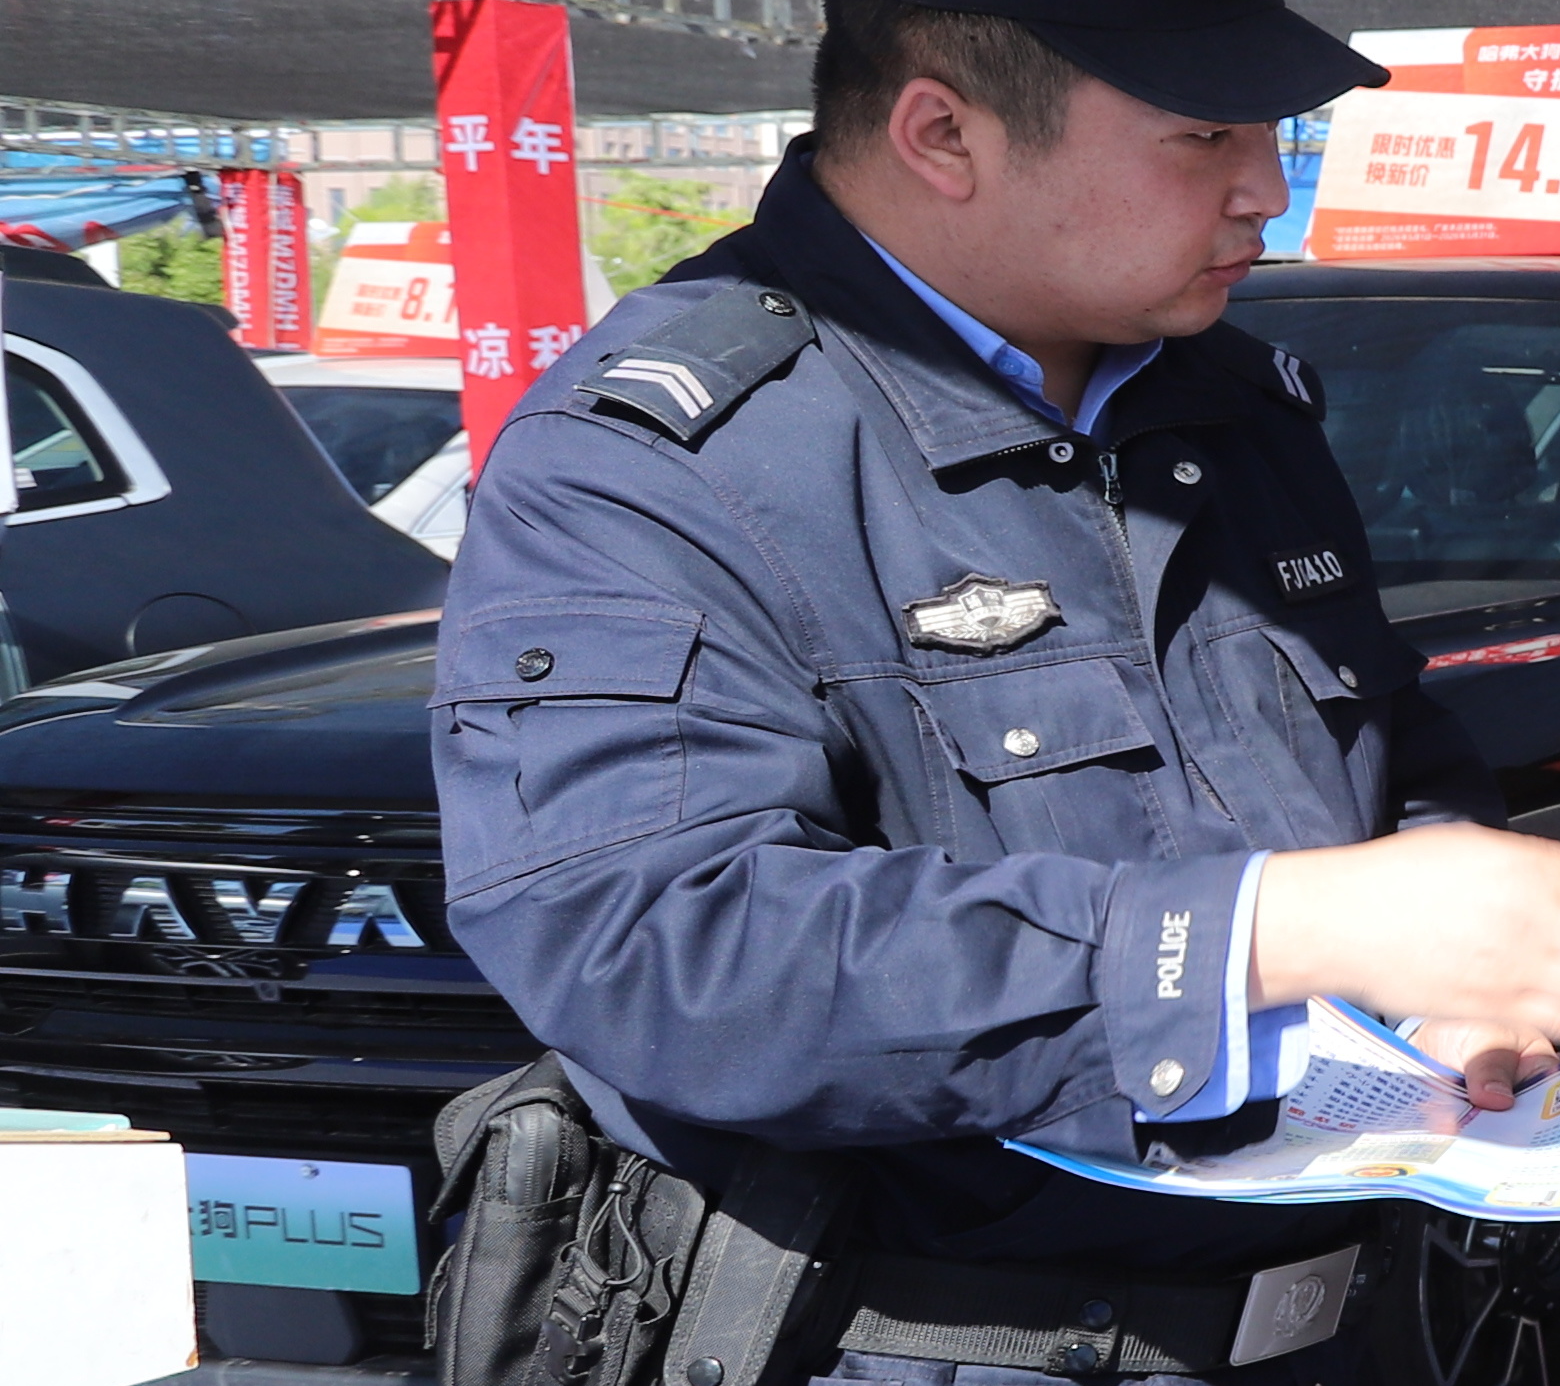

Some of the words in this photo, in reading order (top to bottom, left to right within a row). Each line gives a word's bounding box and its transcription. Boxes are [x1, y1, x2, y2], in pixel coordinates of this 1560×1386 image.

[1370, 133, 1458, 160] 限时优惠
[1365, 161, 1431, 188] 换新价
[0, 869, 426, 948] HAVA
[1157, 909, 1191, 1000] POLICE
[188, 1199, 385, 1248] 狗PLUS
